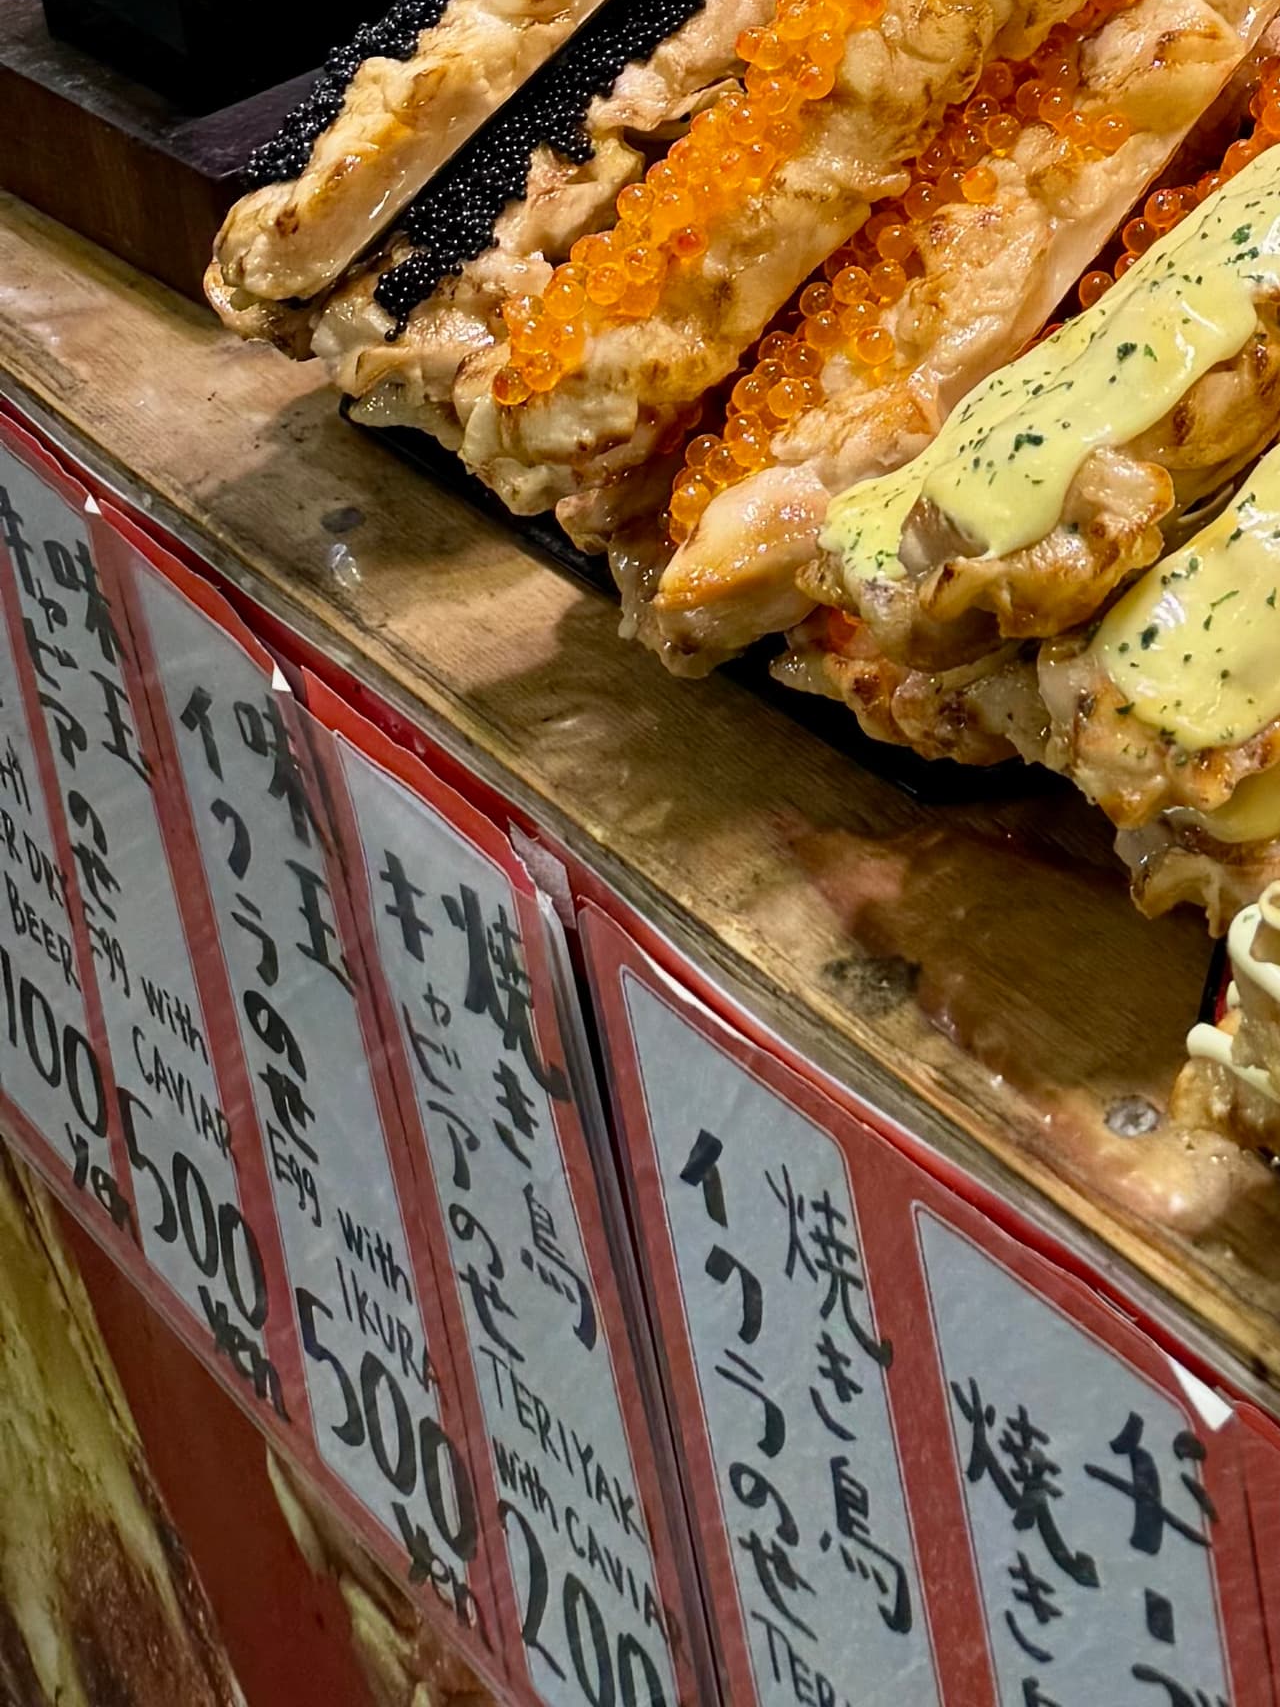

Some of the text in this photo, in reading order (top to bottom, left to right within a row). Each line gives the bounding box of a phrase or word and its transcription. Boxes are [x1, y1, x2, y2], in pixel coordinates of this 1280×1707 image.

[43, 537, 156, 790] 味玉
[2, 869, 82, 992] BEER
[179, 685, 320, 1165] イクラのせ
[232, 692, 357, 997] 味玉
[140, 975, 210, 1067] with
[378, 848, 527, 1364] キャビアのせ
[440, 882, 599, 1353] 焼き鳥
[116, 1086, 269, 1333] 500
[266, 1119, 414, 1305] Egg with
[334, 1256, 443, 1395] IKURA
[296, 1286, 477, 1563] 500
[492, 1434, 560, 1533] with
[679, 1128, 819, 1642] イクラのせ
[764, 1162, 913, 1635] 焼き鳥
[949, 1375, 1101, 1707] 焼き
